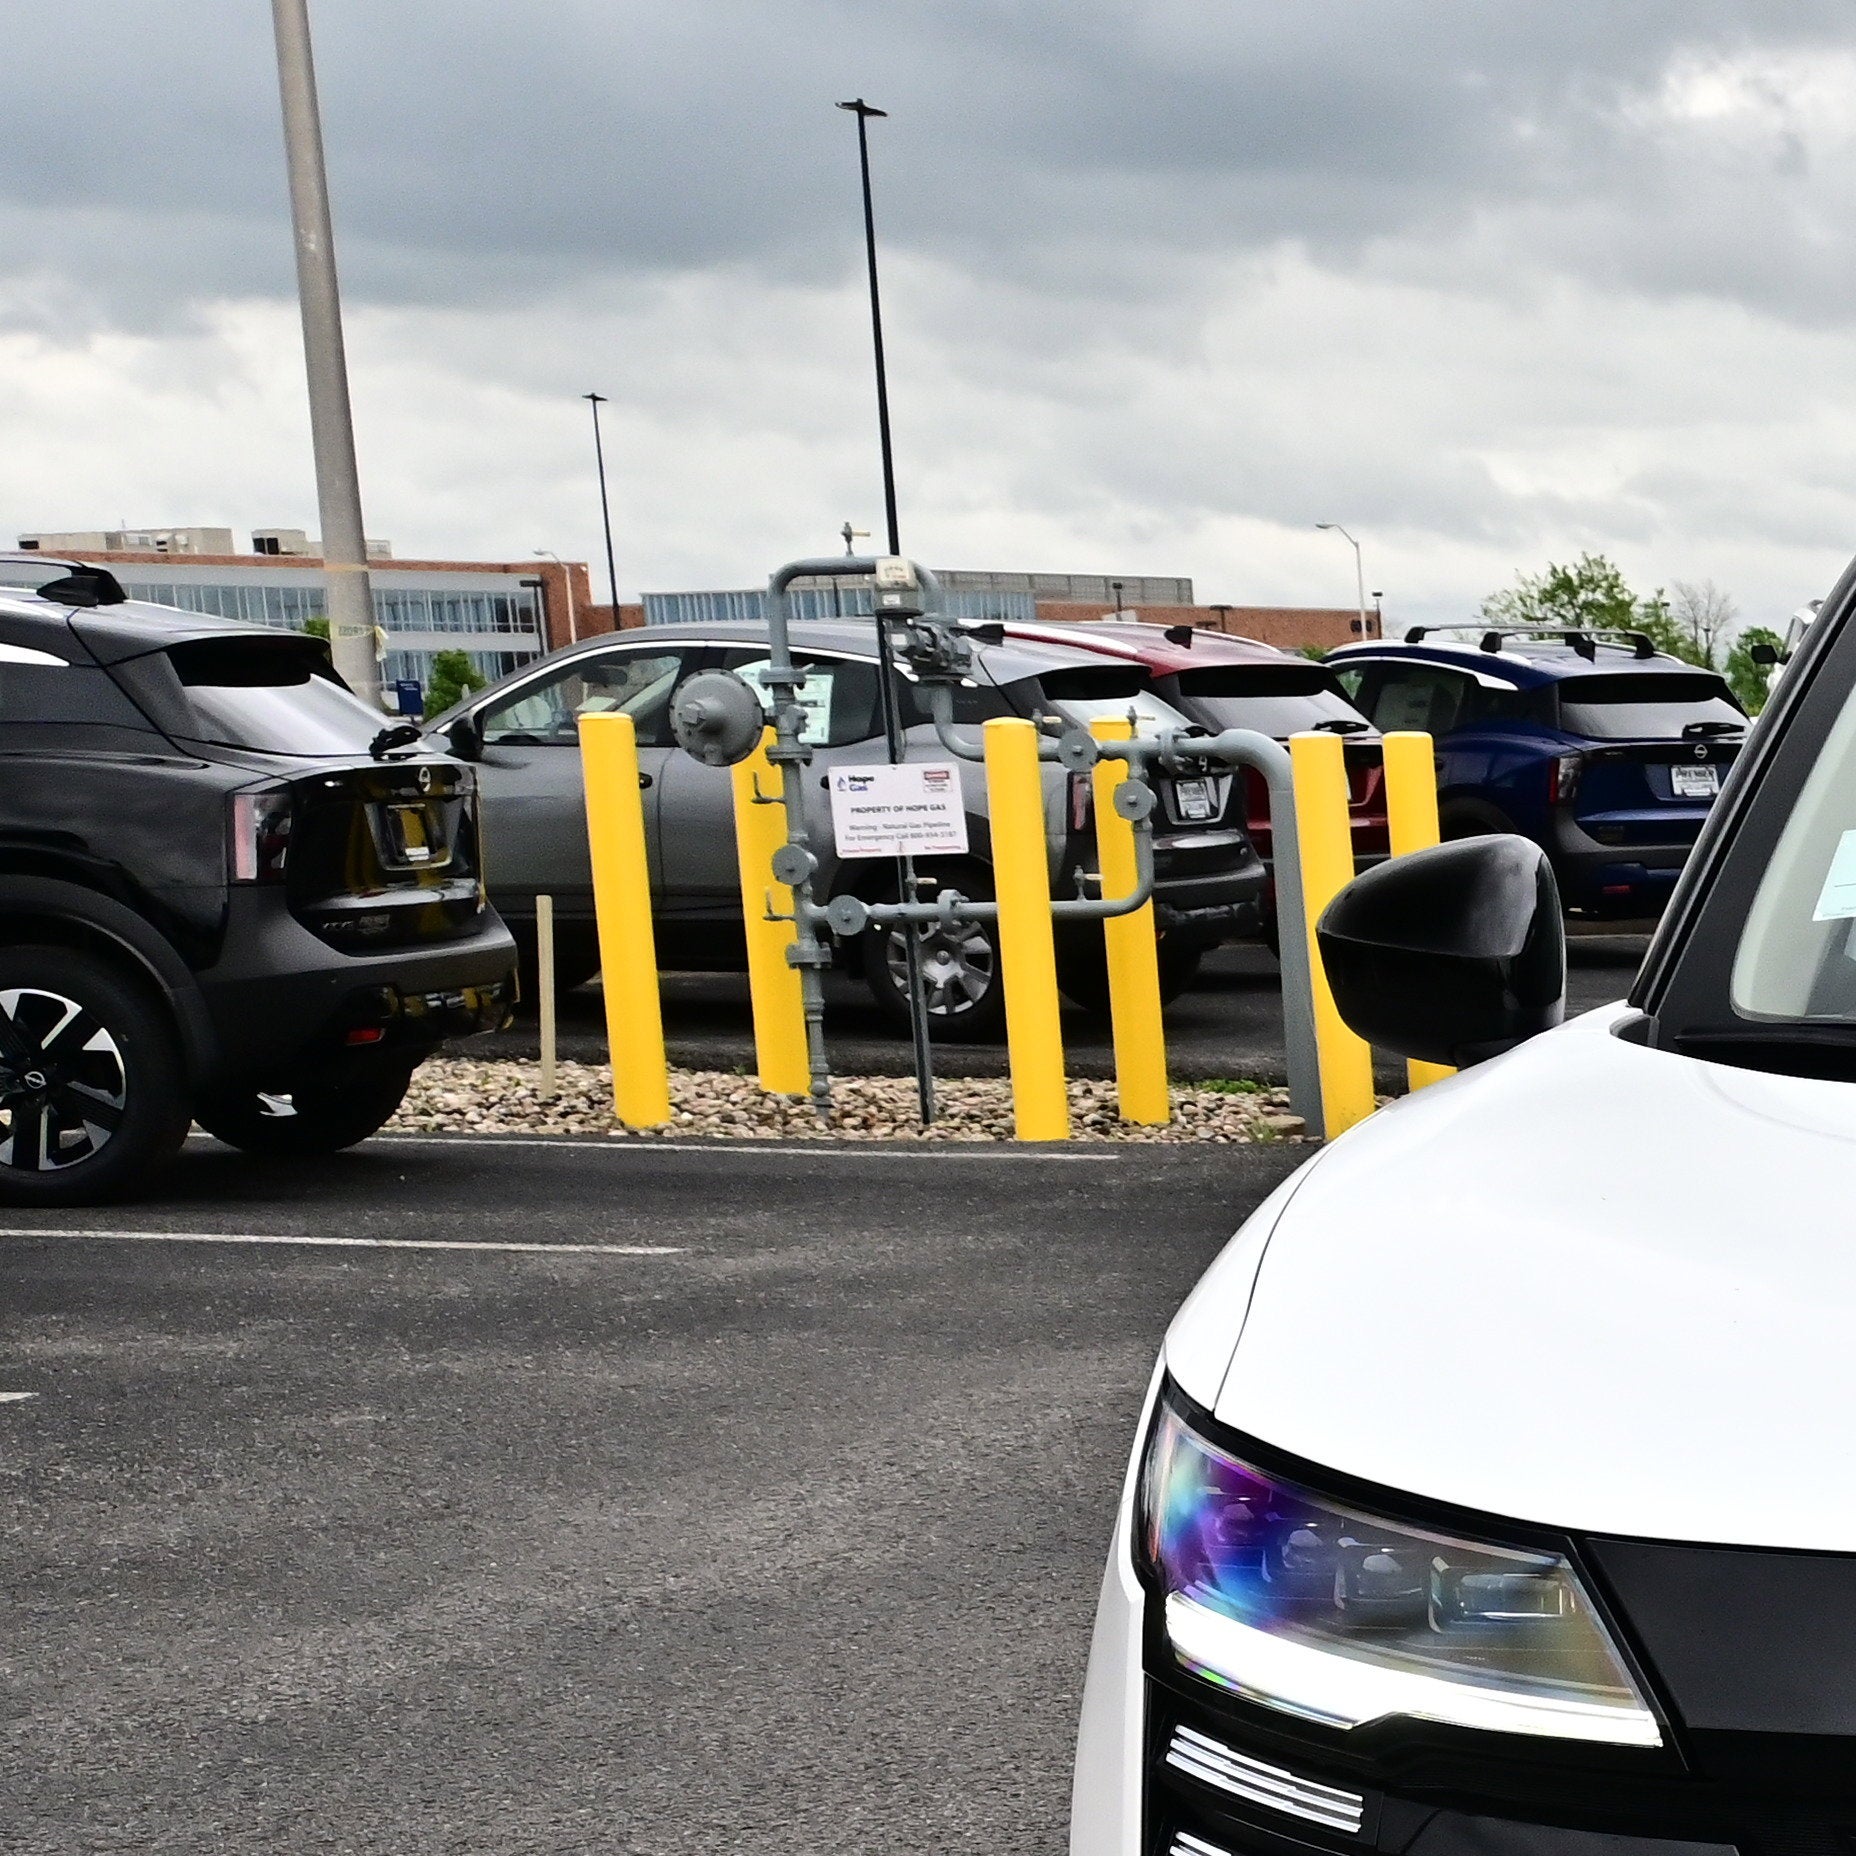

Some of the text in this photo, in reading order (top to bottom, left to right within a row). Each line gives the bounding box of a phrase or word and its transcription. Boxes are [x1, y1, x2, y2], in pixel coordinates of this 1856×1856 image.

[848, 775, 874, 784] Hope
[849, 784, 868, 792] Gas
[850, 806, 891, 814] PROPERTY
[906, 804, 928, 812] HOPE
[930, 803, 946, 811] GAS
